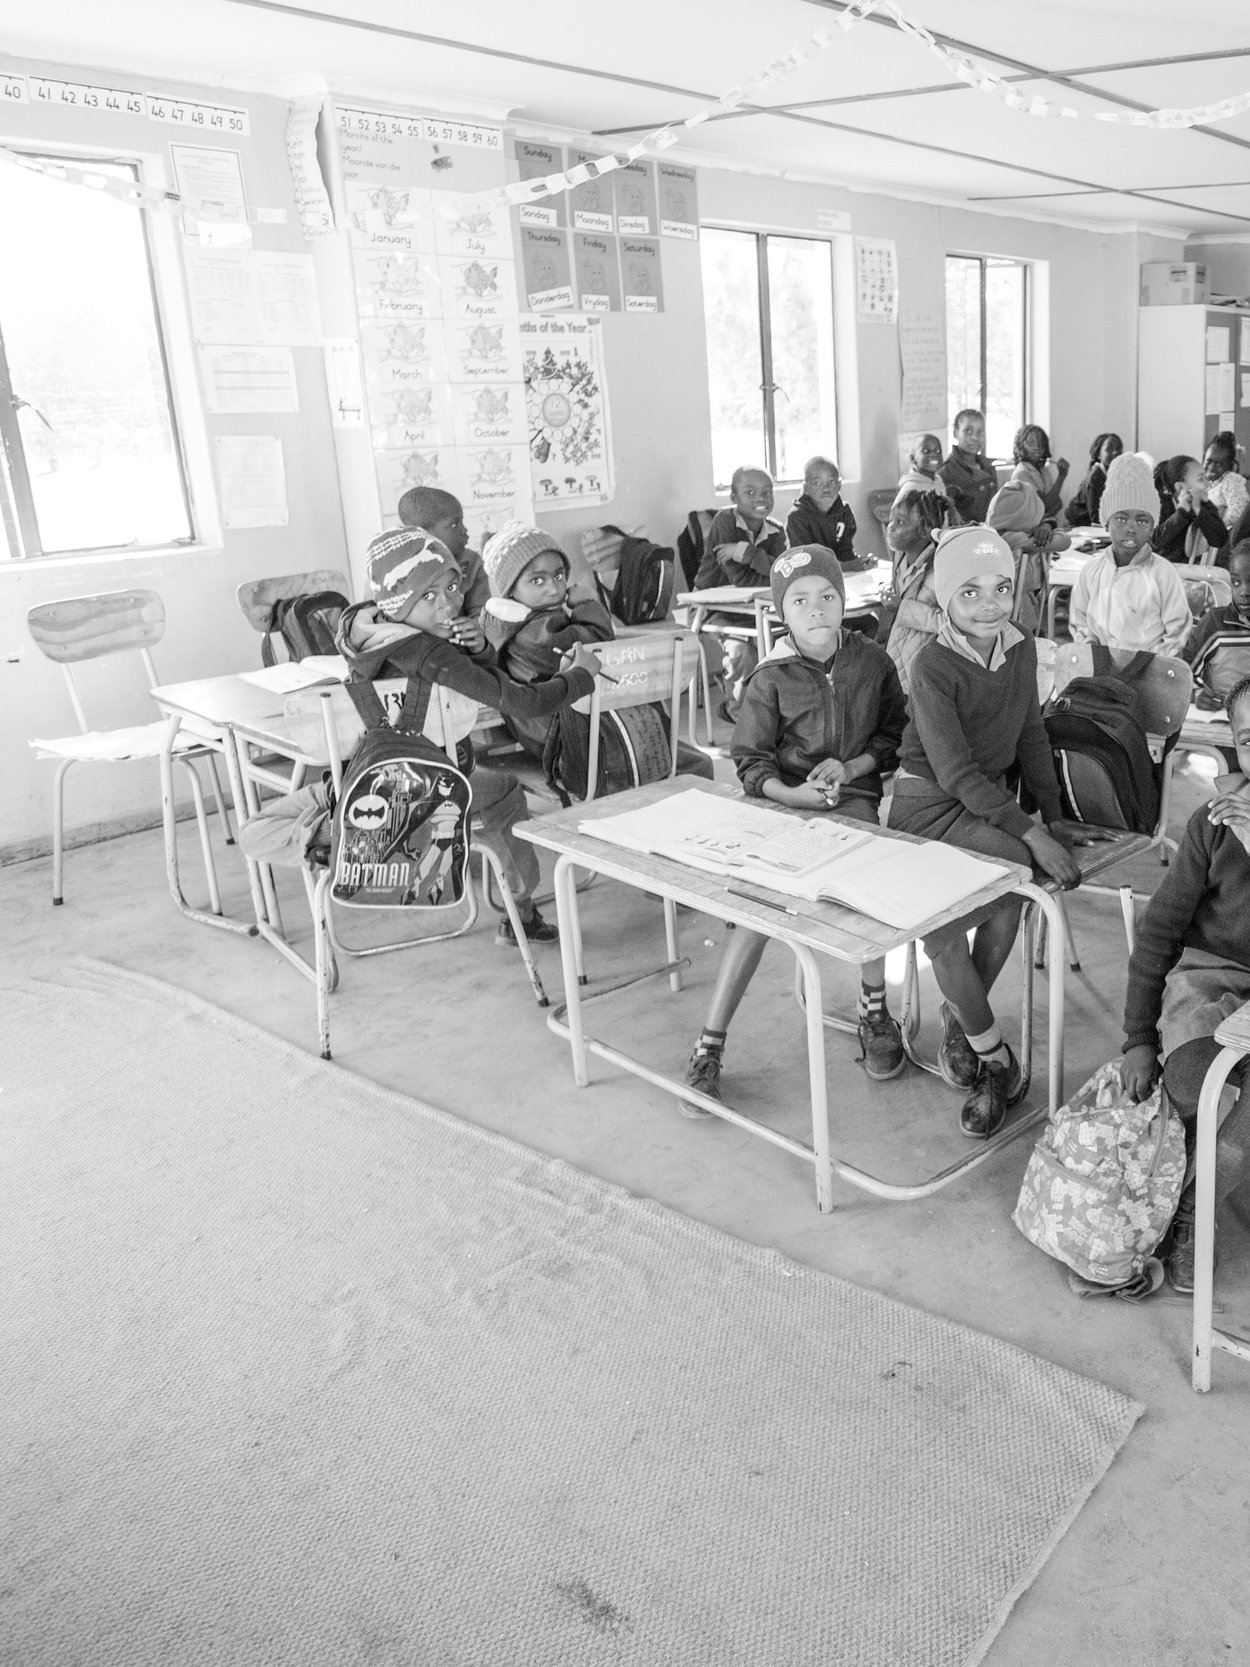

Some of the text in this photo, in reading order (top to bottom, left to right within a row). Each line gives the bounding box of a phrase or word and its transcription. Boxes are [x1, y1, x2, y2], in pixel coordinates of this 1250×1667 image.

[4, 84, 243, 131] 40 41 42 43 44 45 46 47 48 49 50
[339, 128, 393, 146] Months of the
[341, 116, 498, 146] 51 52 53 54 55 56 57 58 59 60
[523, 145, 553, 163] Sunday
[343, 155, 401, 171] Maande van die
[576, 213, 609, 230] Maandag
[619, 219, 646, 232] Dinsdag
[370, 233, 413, 248] January
[527, 231, 561, 246] Thursday
[583, 237, 606, 253] Friday
[465, 239, 485, 255] July
[531, 291, 571, 306] Donderdag
[584, 299, 609, 310] Vrydag
[465, 304, 497, 320] August
[520, 321, 587, 334] nths of the Year
[392, 366, 423, 380] March
[463, 366, 510, 380] September
[550, 397, 561, 409] 12
[404, 430, 425, 444] April
[474, 426, 510, 439] October
[473, 488, 516, 500] November
[339, 862, 410, 886] BATMAN
